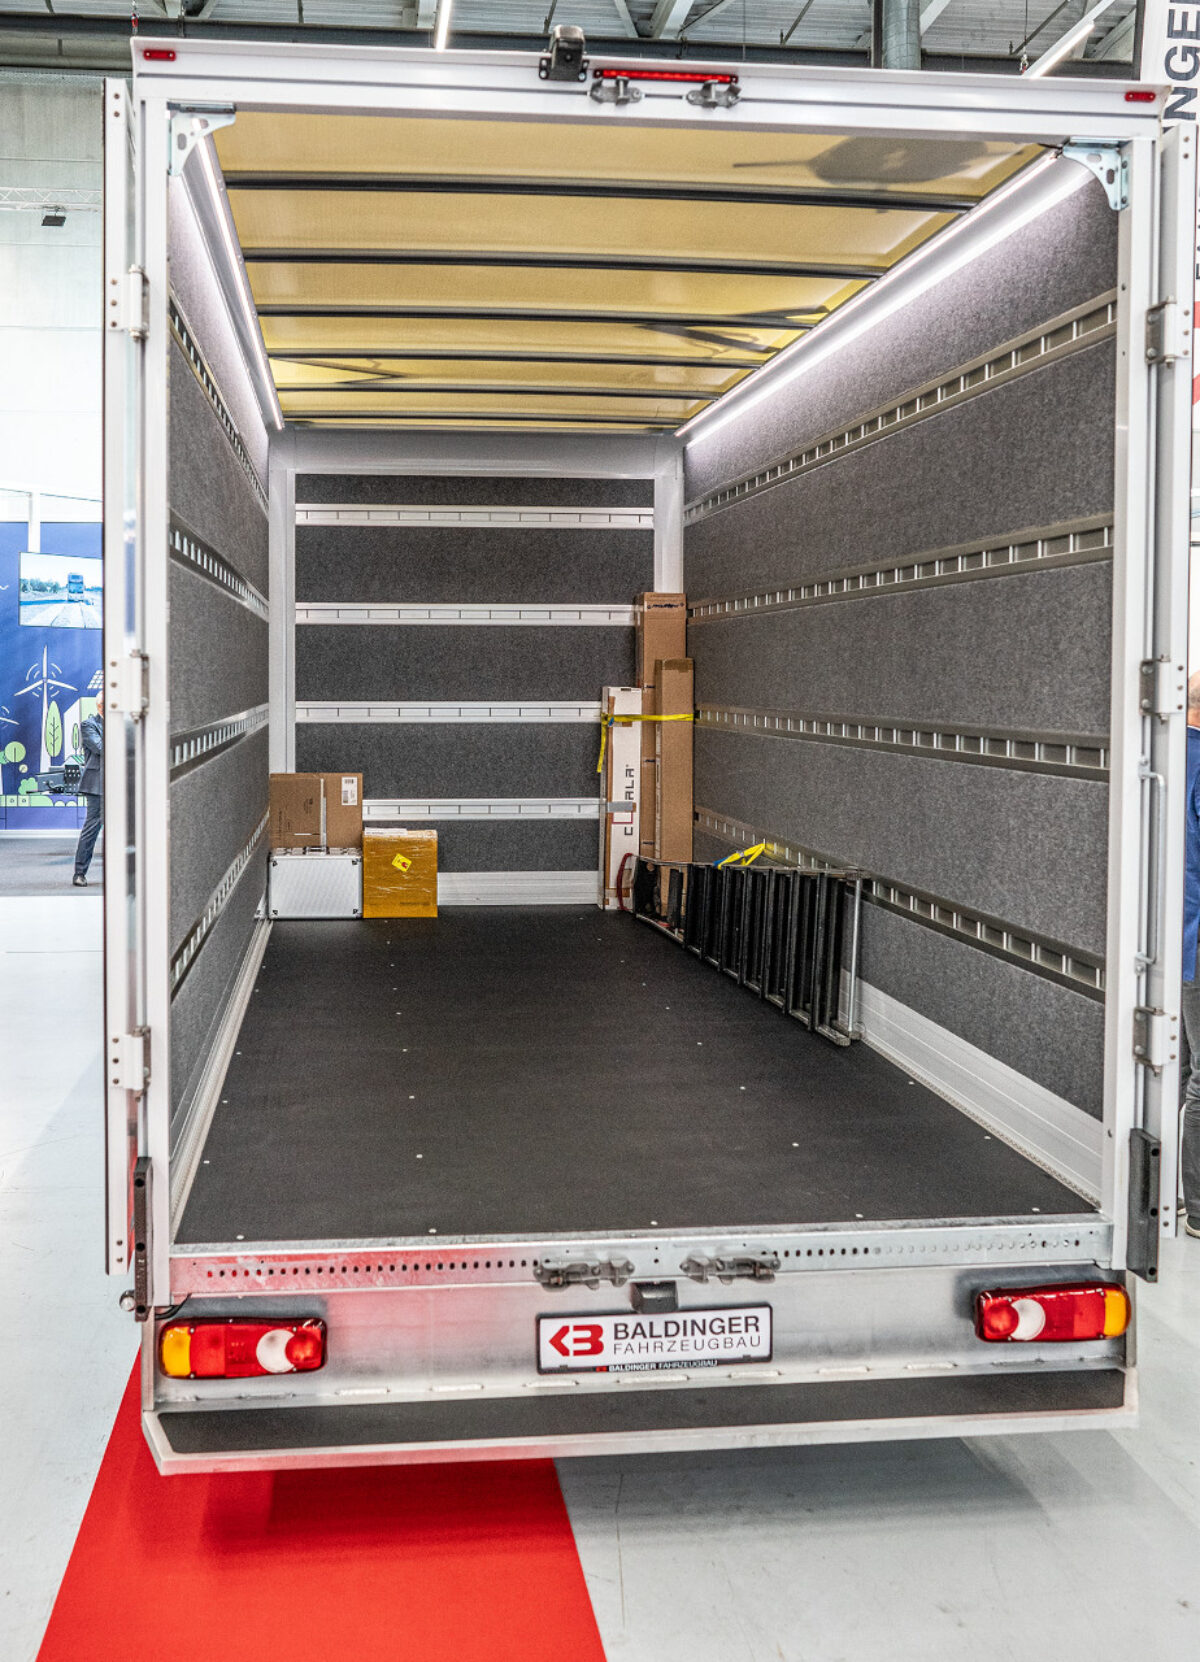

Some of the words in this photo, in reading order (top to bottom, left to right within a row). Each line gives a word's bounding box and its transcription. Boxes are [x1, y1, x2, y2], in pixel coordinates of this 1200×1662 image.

[613, 1315, 760, 1340] BALDINGER
[613, 1335, 761, 1355] FAHRZEUGBAU
[608, 1362, 657, 1372] BALDINGER
[658, 1360, 718, 1370] FAHRZEUGBAU
